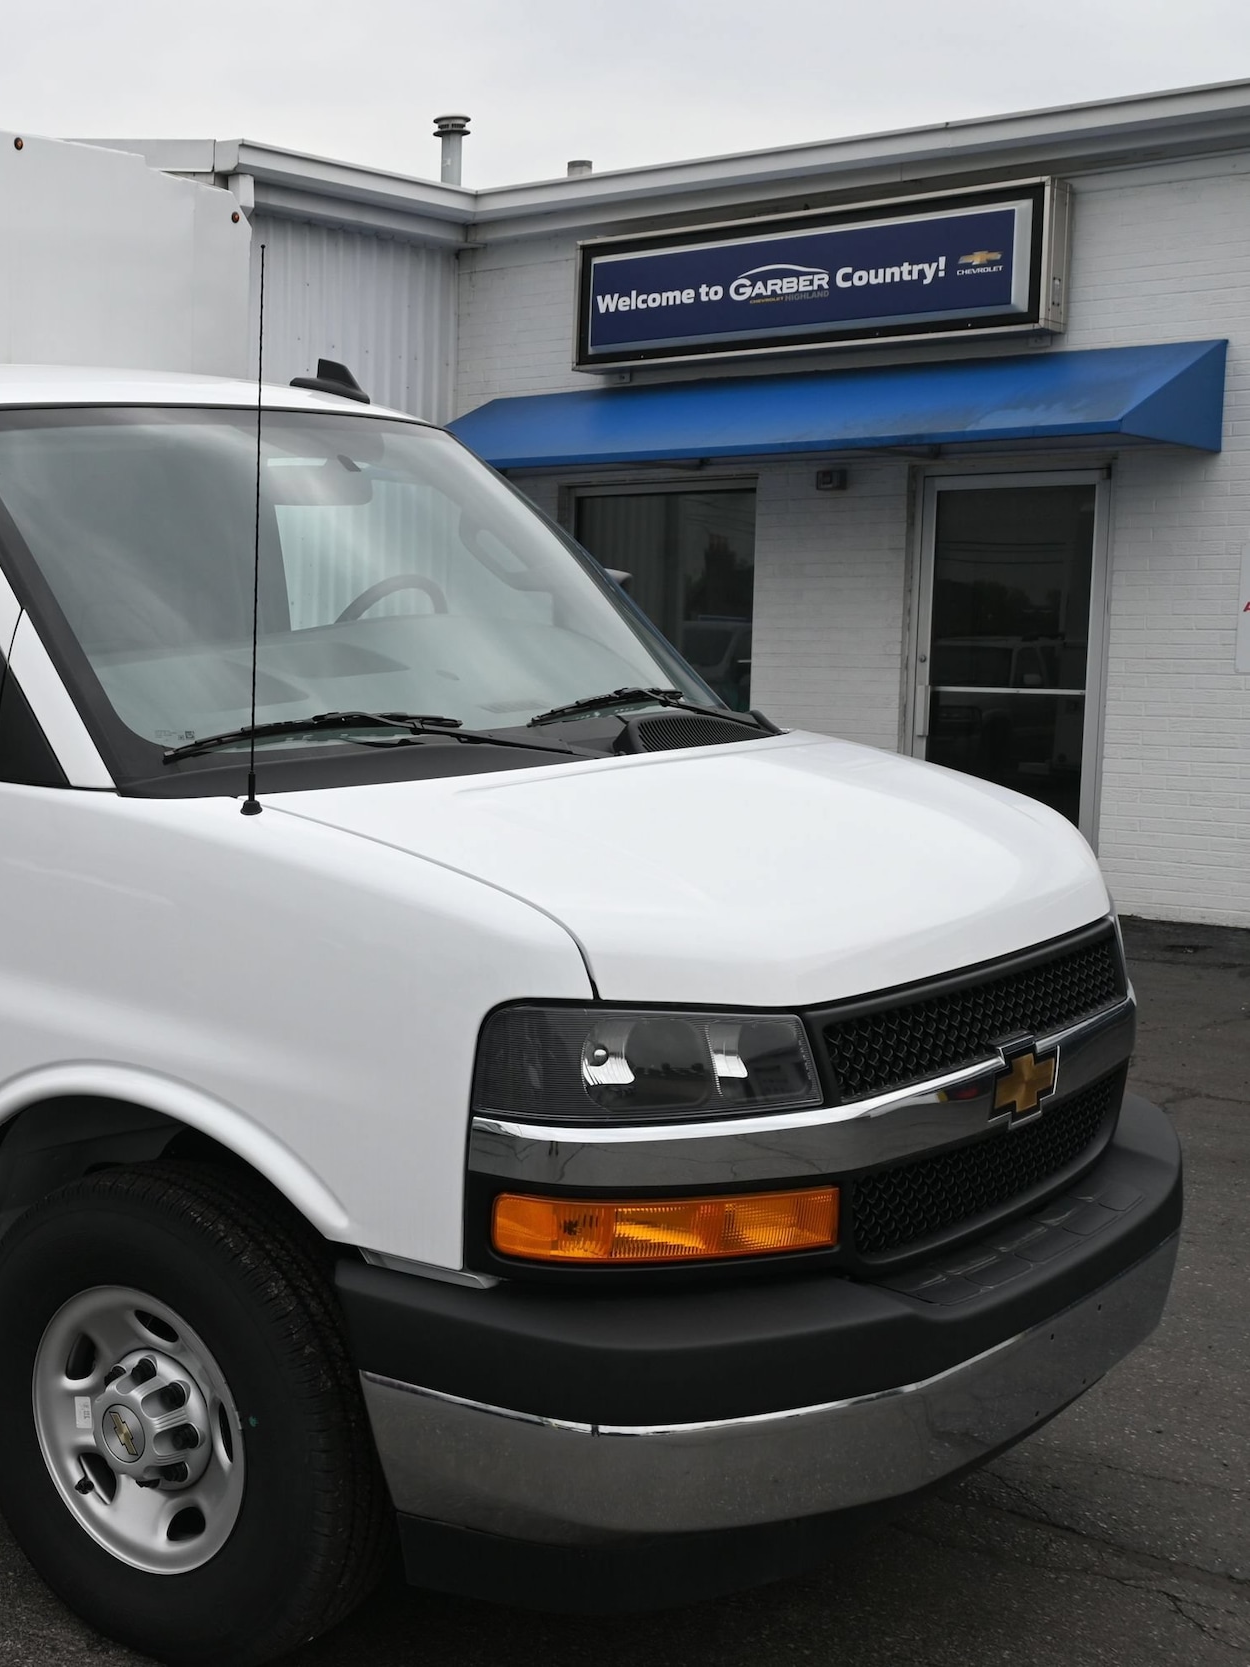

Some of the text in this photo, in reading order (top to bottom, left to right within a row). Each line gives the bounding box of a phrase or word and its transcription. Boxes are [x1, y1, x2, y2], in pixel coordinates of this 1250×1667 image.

[956, 265, 1004, 276] CHEVROLET
[596, 256, 946, 314] Welcome to GARBER Country!
[749, 290, 830, 305] CHEVROLET HIGHLAND
